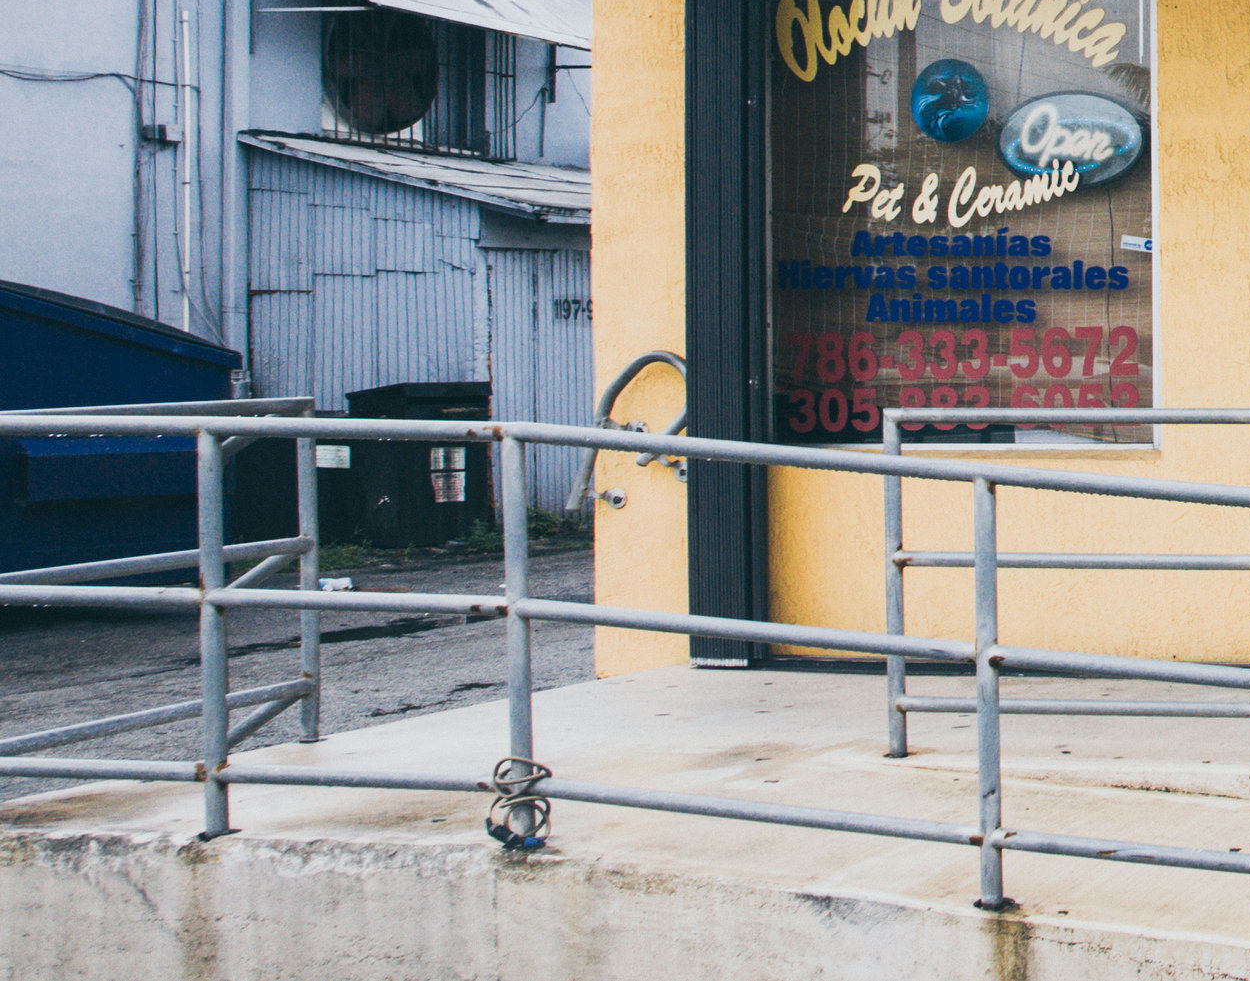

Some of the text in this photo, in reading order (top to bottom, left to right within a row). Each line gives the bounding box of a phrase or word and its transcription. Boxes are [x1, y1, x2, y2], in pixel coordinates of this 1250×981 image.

[1020, 104, 1115, 166] Open
[842, 160, 1080, 228] Pet & Ceramic
[851, 227, 1052, 258] Artesanías
[777, 260, 1130, 290] Hiervas santorales
[865, 293, 1037, 323] Animales
[787, 326, 1139, 383] 786-333-5672
[788, 383, 1140, 433] 3058836052
